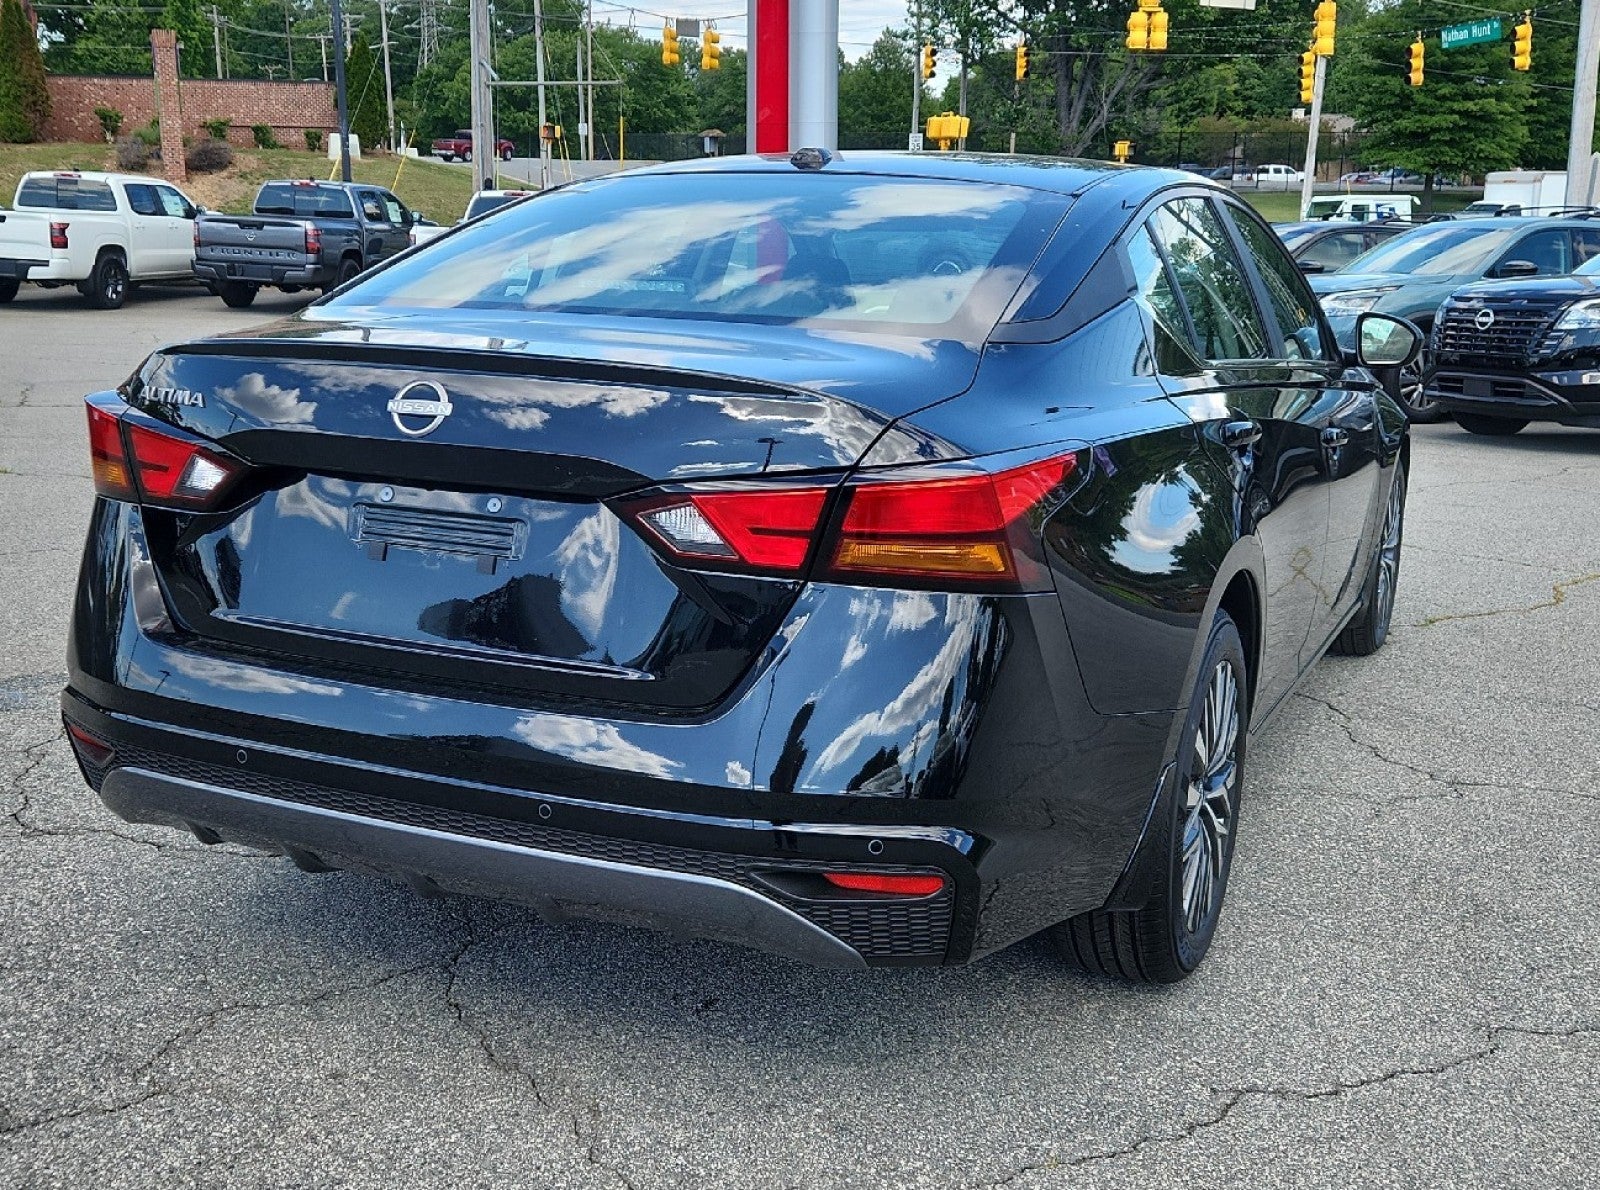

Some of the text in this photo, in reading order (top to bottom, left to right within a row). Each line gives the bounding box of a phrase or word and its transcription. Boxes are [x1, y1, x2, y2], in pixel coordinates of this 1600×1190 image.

[1441, 29, 1469, 43] Nathan
[1471, 23, 1491, 38] Hunt
[911, 142, 921, 151] 35
[209, 246, 298, 260] FRONTIER
[140, 385, 205, 408] ALTIMA
[388, 401, 452, 416] NISSAN
